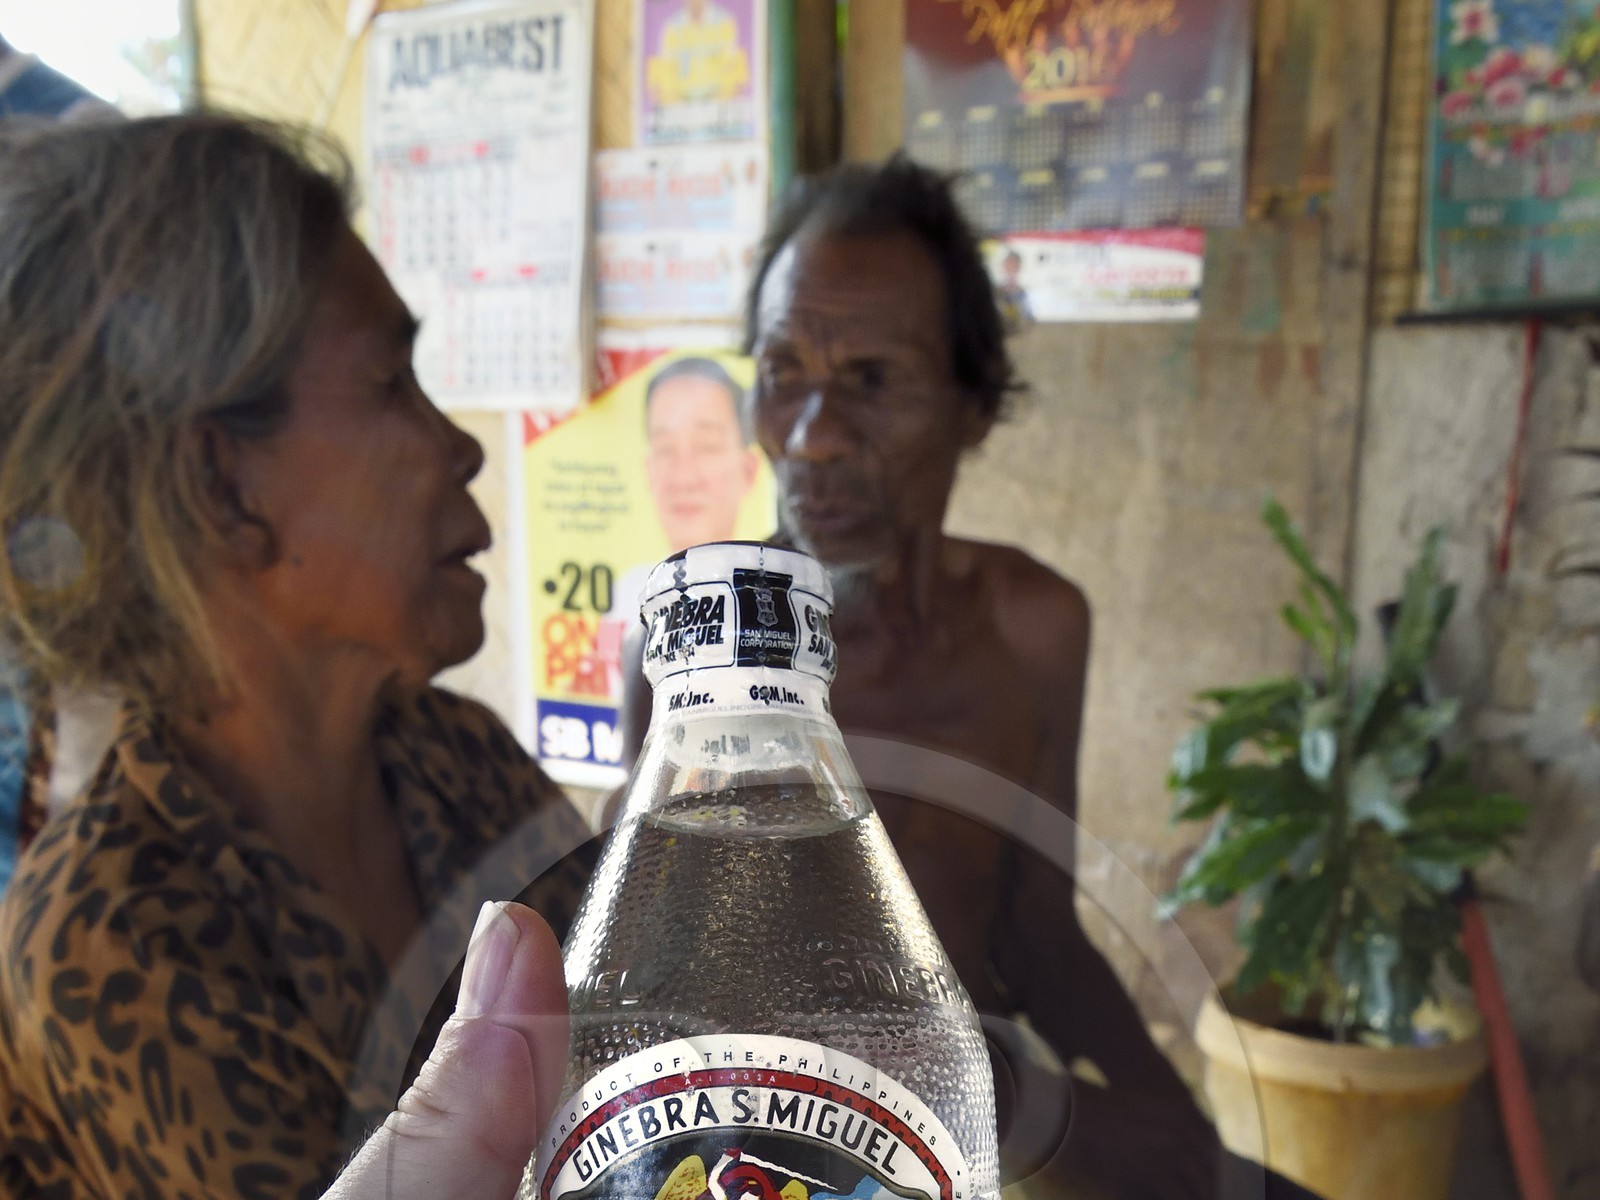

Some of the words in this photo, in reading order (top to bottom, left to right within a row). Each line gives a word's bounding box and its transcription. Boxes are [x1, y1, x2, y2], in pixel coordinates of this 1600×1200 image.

[389, 16, 562, 92] AQUABEST
[650, 595, 725, 635] GNEBRA
[744, 629, 761, 638] SAN
[764, 630, 791, 640] MIGUEL
[552, 1072, 633, 1148] PRODUCT
[654, 1057, 681, 1073] OF
[704, 1052, 754, 1064] THE
[778, 1054, 937, 1147] PHILIPPINES
[572, 1091, 720, 1182] GINEBRA
[767, 1091, 897, 1176] MIGUEL
